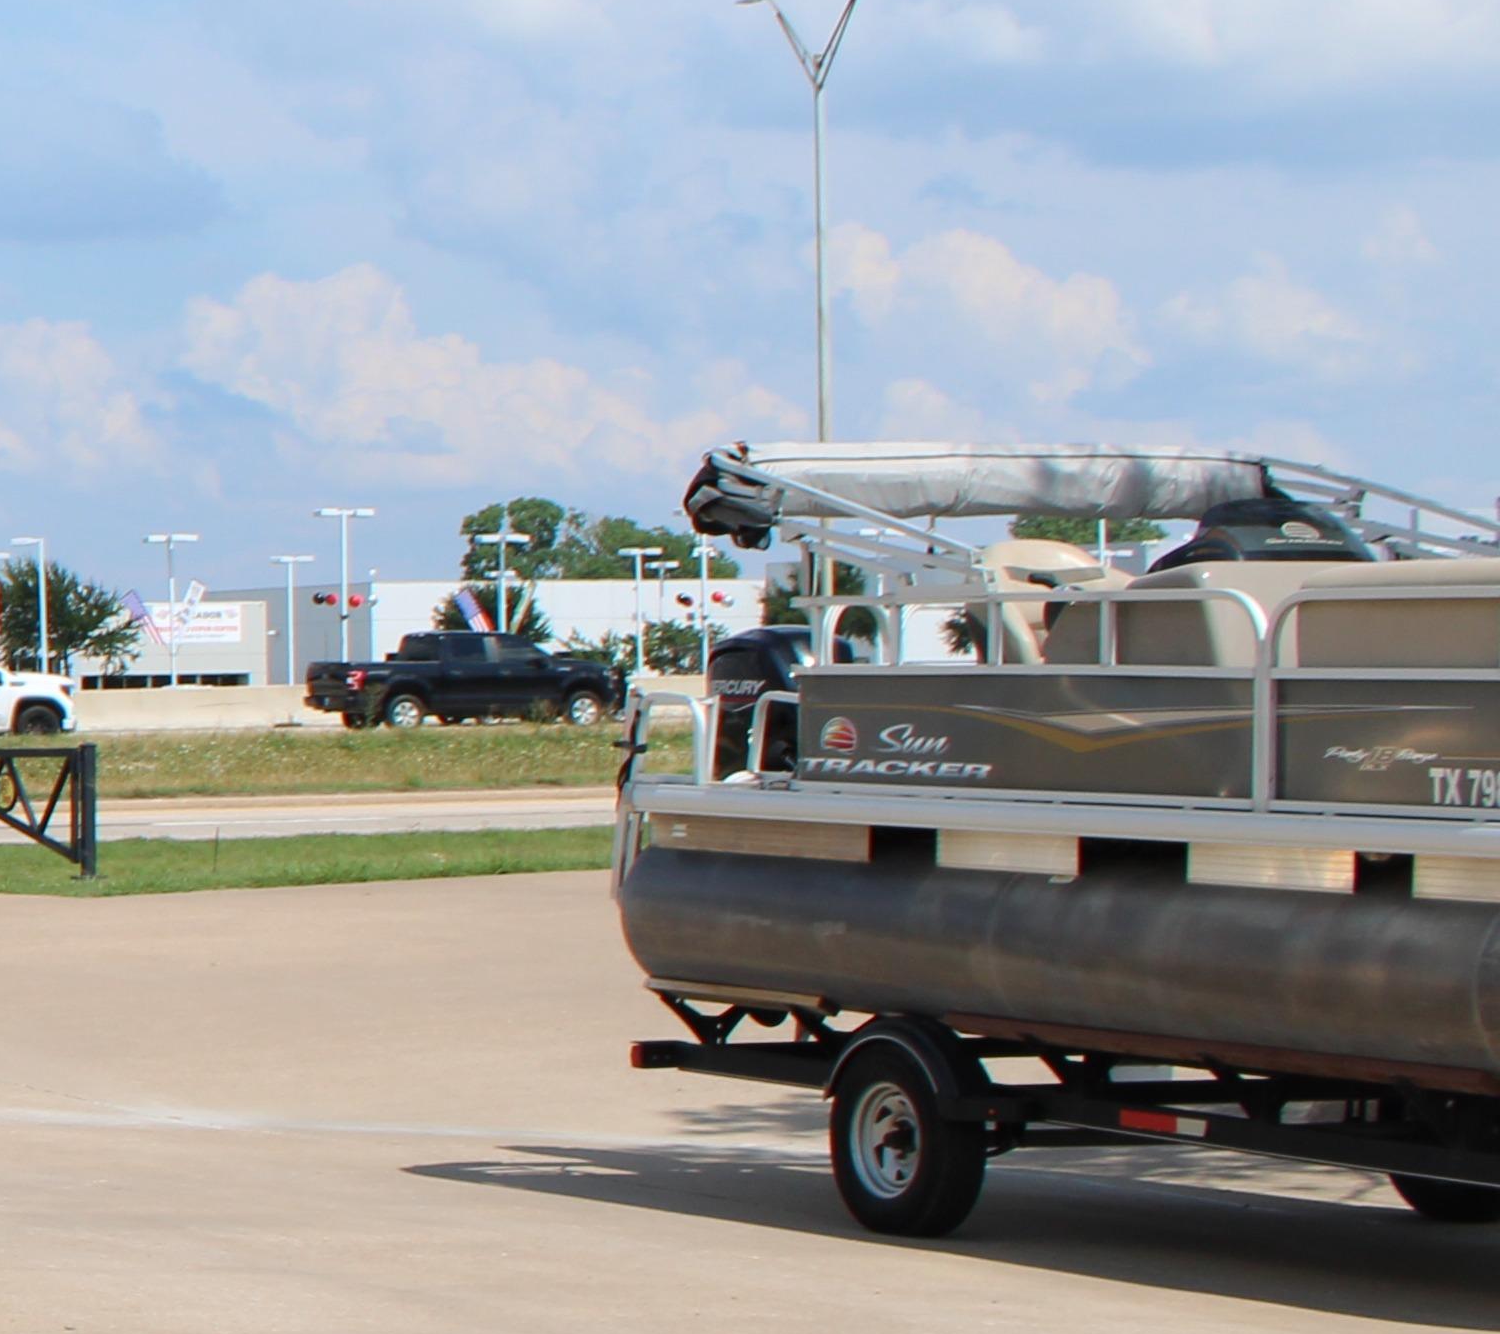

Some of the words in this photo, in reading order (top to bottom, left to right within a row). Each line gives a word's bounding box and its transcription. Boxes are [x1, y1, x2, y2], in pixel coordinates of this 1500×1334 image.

[875, 723, 950, 756] Sun
[800, 756, 993, 780] TRACKER
[1429, 767, 1463, 805] TX
[1467, 769, 1500, 808] 79
